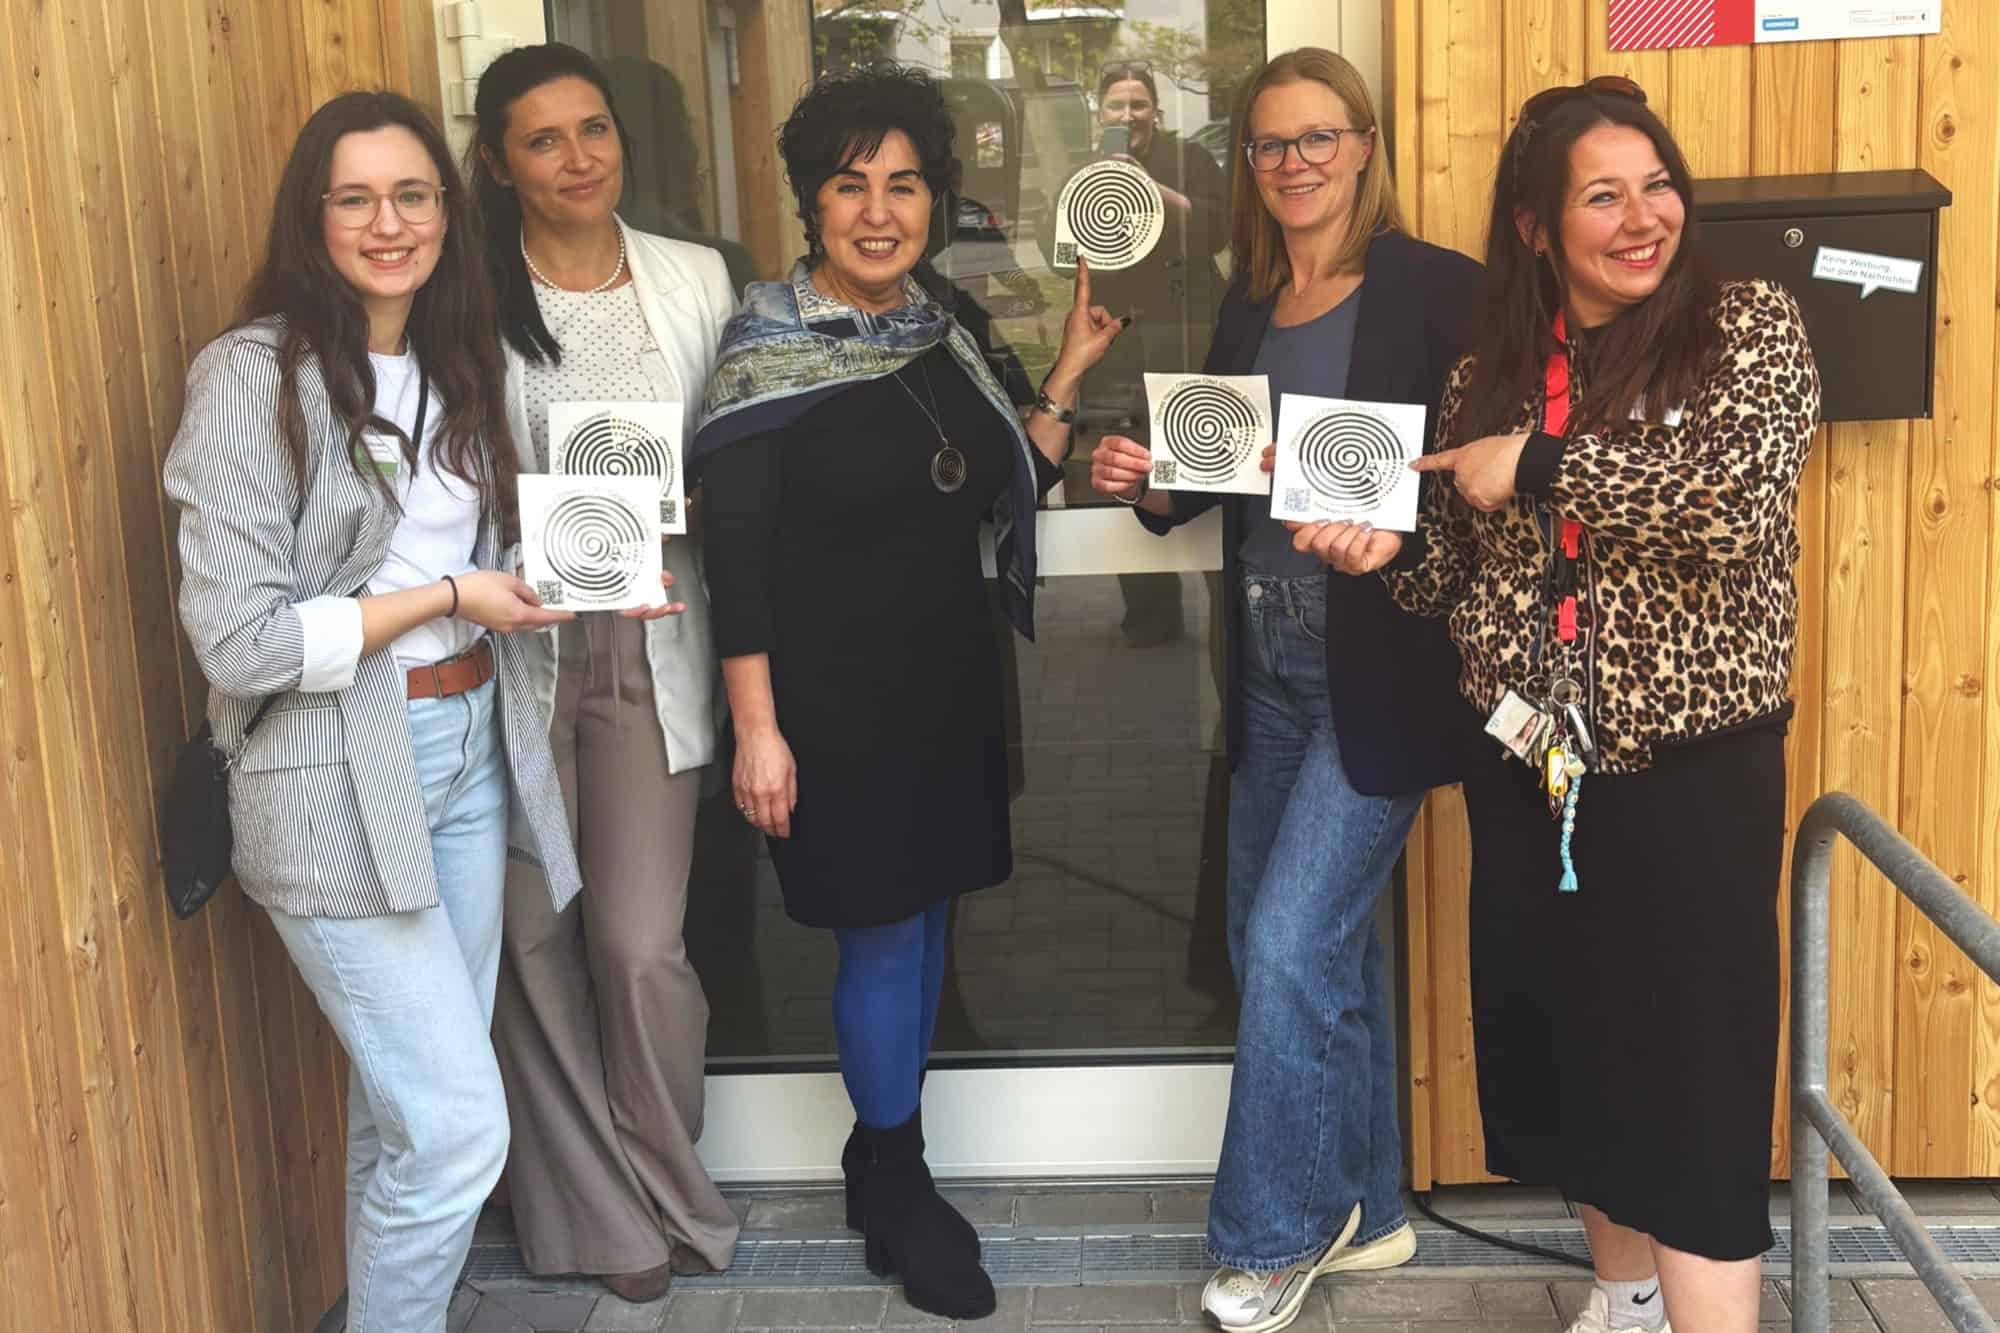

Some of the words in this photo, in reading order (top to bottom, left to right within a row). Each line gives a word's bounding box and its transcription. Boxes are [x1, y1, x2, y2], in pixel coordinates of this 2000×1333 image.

[1822, 254, 1848, 265] Keine
[1820, 265, 1836, 273] nur
[1838, 267, 1858, 277] gute
[1860, 270, 1913, 285] Nachrichten
